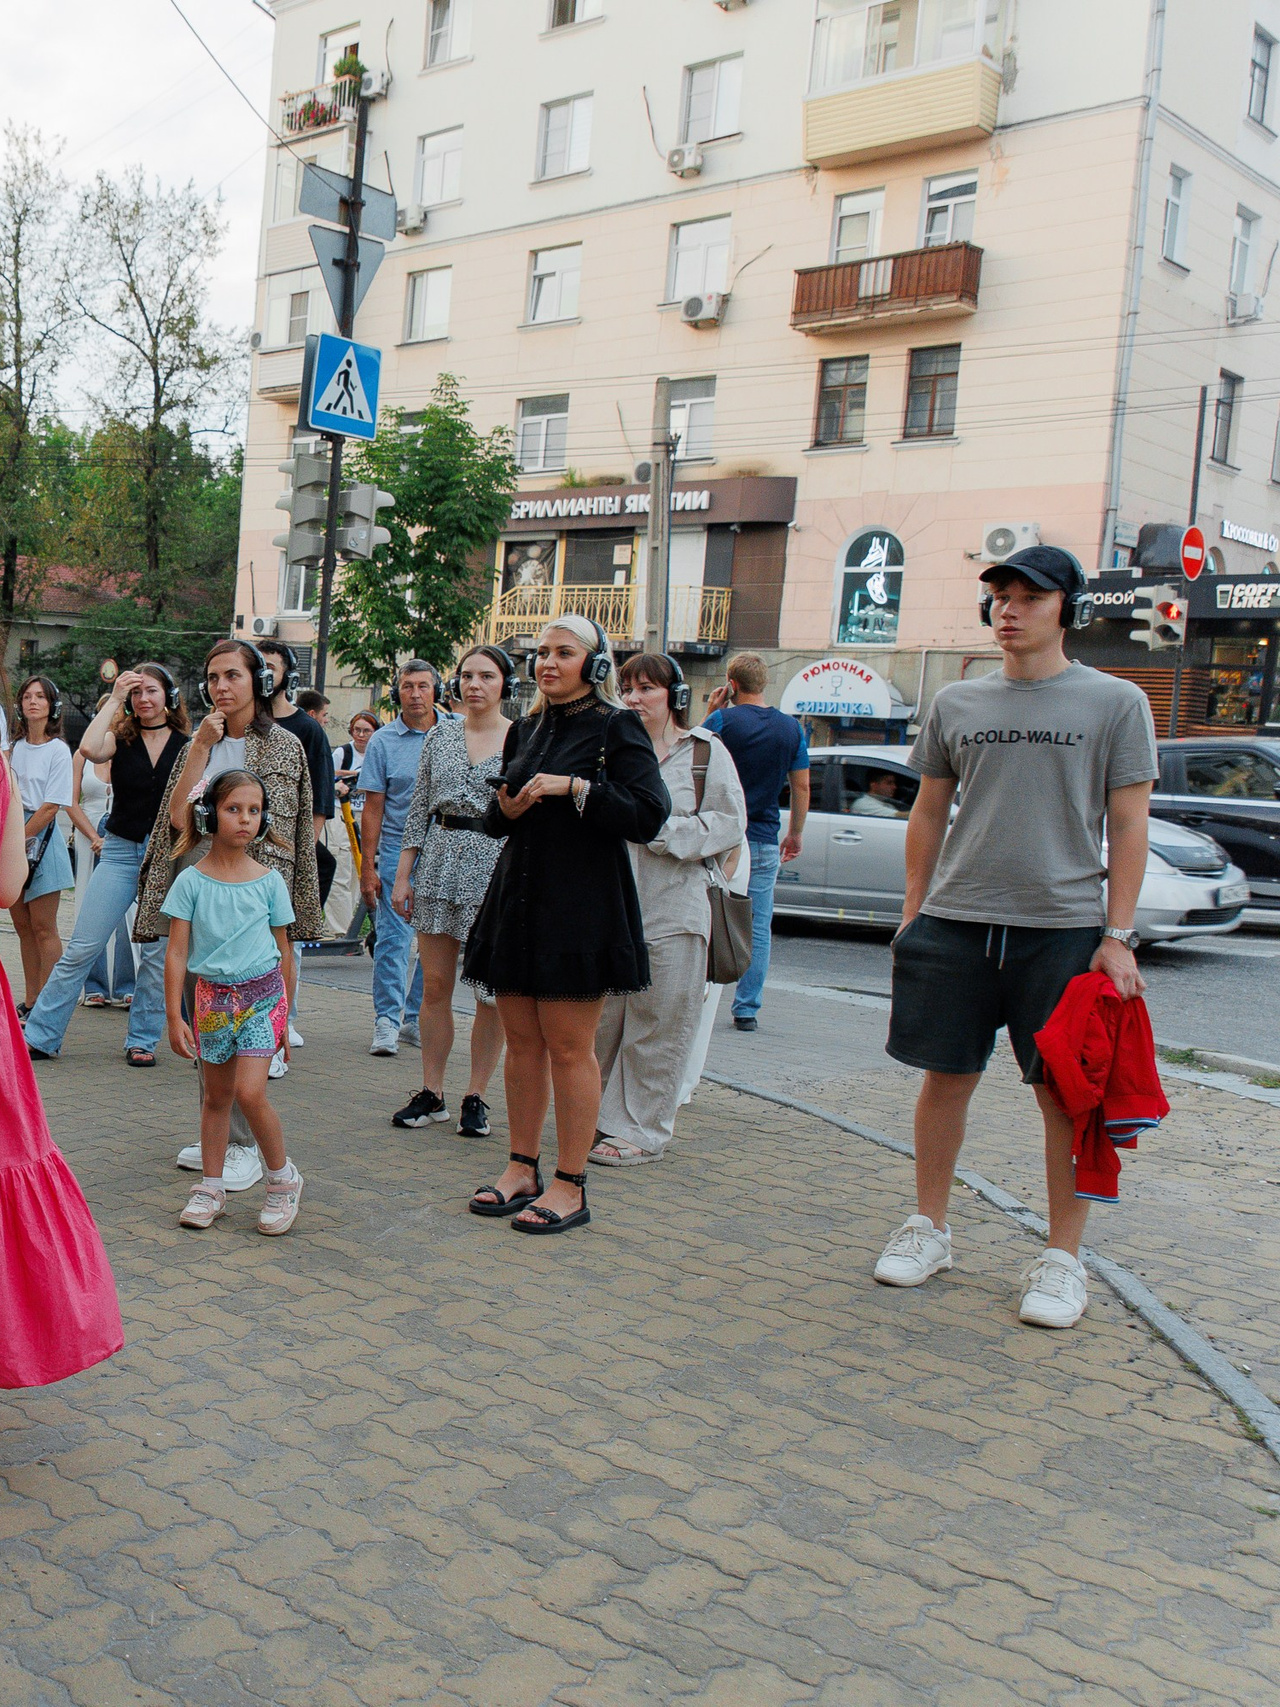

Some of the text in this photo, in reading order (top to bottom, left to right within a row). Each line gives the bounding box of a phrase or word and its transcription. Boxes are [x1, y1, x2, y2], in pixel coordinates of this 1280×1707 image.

[510, 490, 711, 520] БРИЛЛИАНТЫ ЯКТИИ
[1088, 590, 1135, 605] ОБОЙ
[1231, 595, 1270, 608] LIKE
[802, 661, 873, 684] РЮМОЧНАЯ
[794, 700, 874, 716] СИНИЧКА
